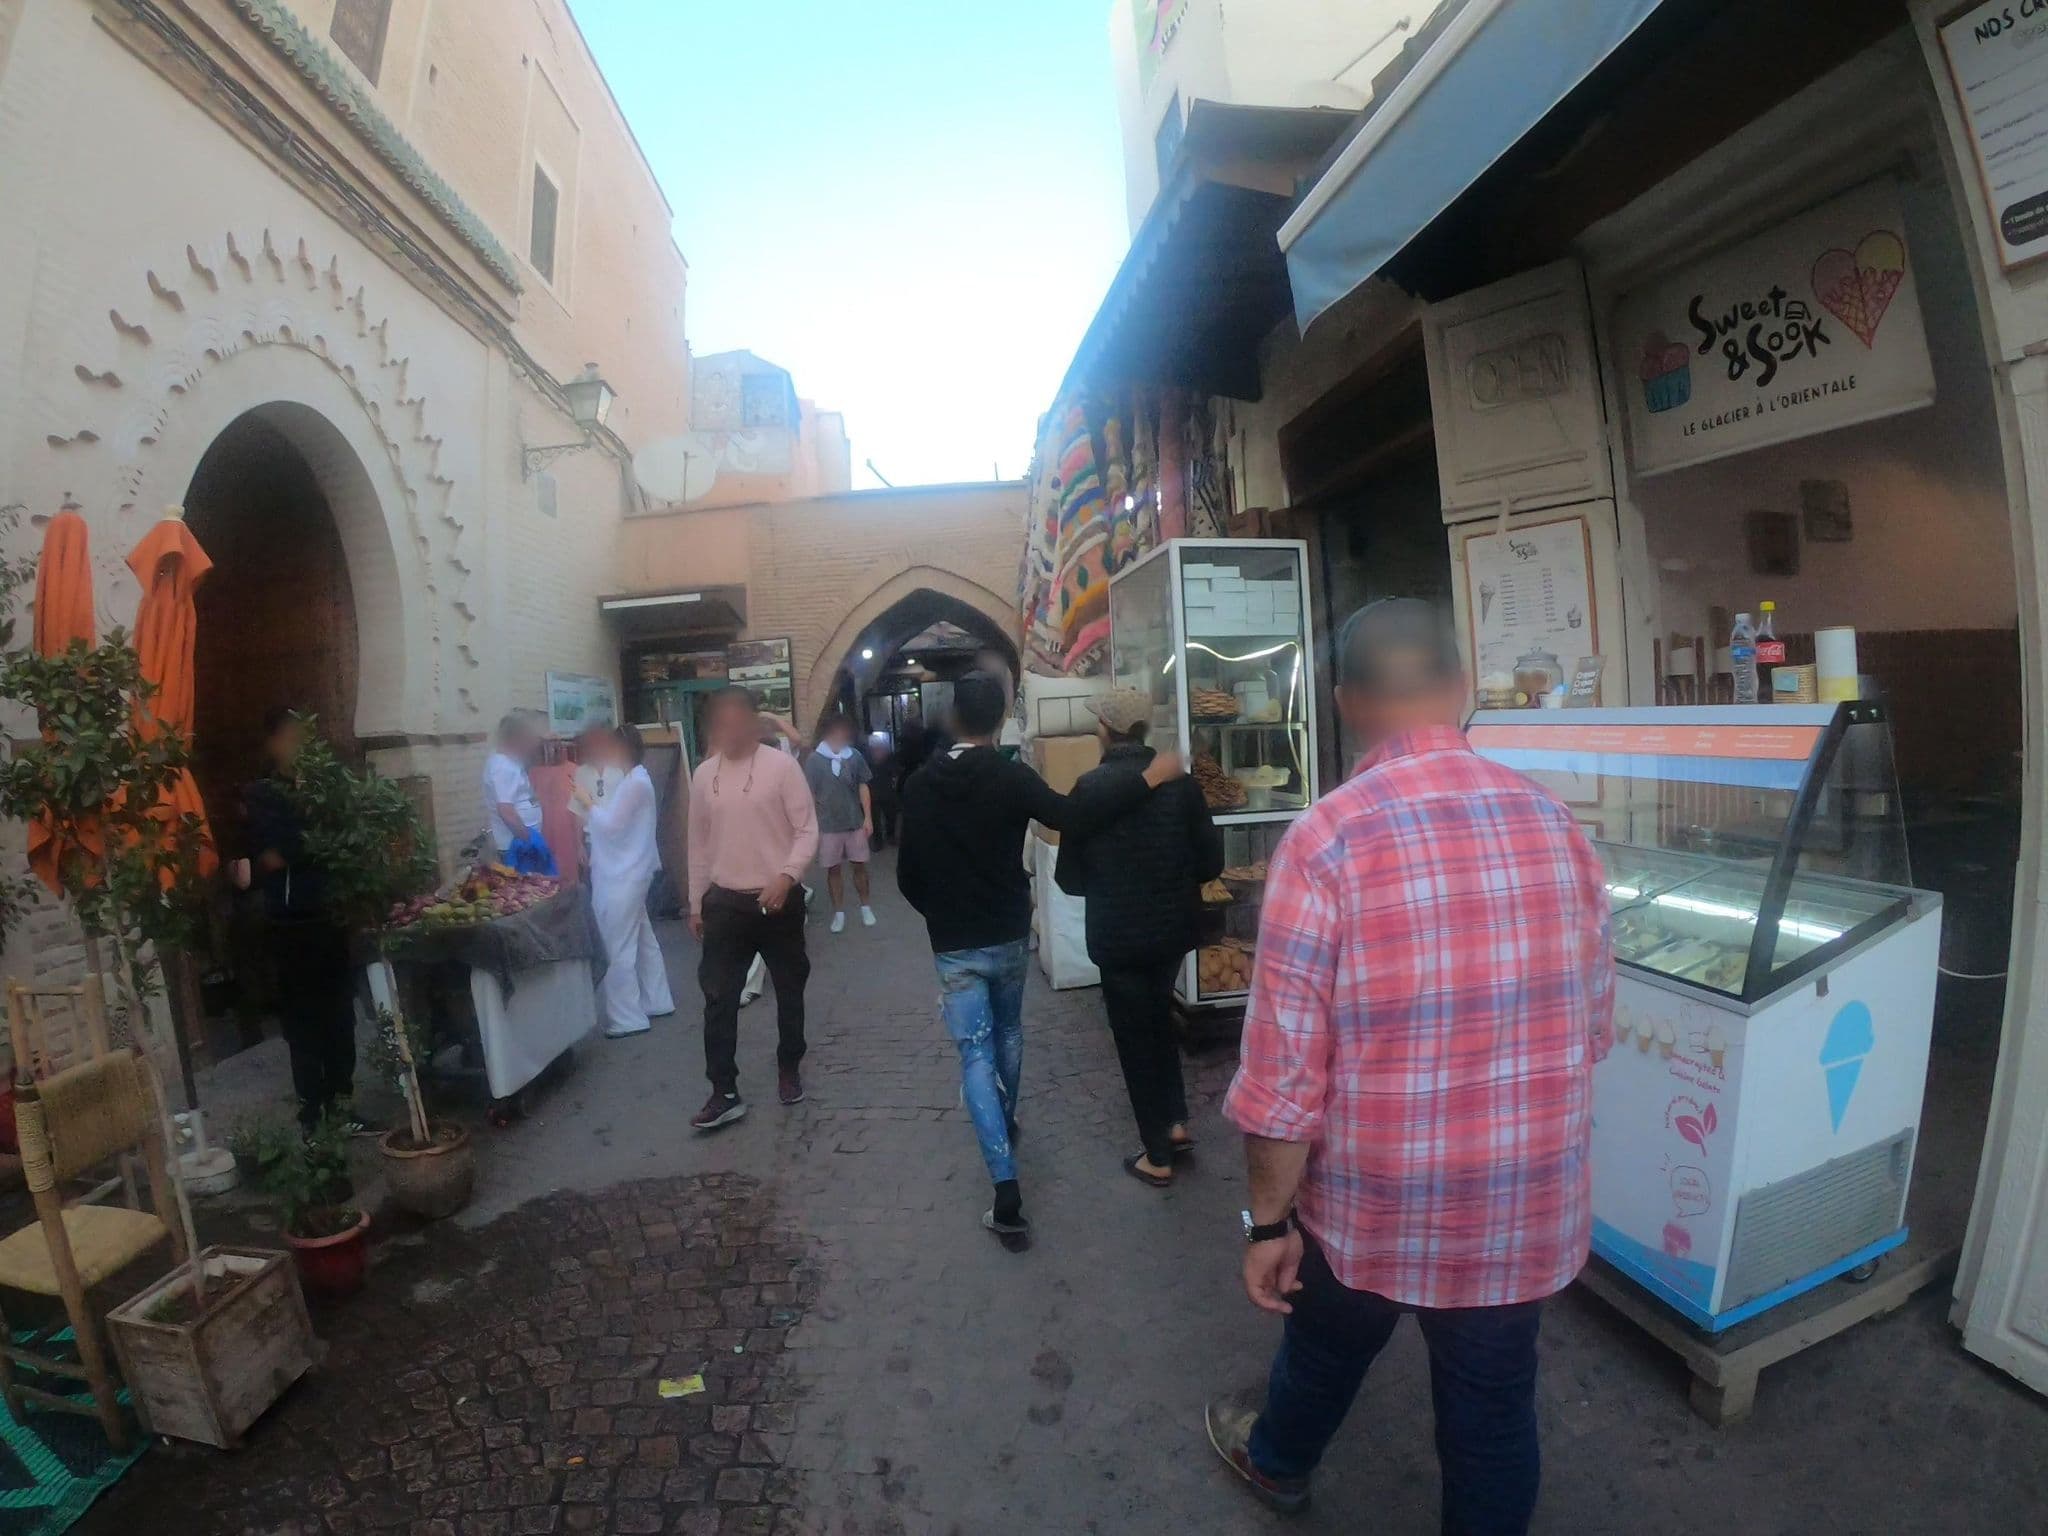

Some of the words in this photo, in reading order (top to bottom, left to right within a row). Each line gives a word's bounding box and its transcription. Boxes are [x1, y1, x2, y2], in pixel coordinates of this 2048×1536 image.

[1974, 7, 2015, 45] NOS
[1688, 285, 1787, 355] Sweet
[1722, 338, 1749, 381] &
[1746, 317, 1831, 387] Sook
[1683, 422, 1697, 437] LE
[1701, 406, 1750, 431] GLACIER
[1769, 375, 1857, 412] L'ORIENTALE
